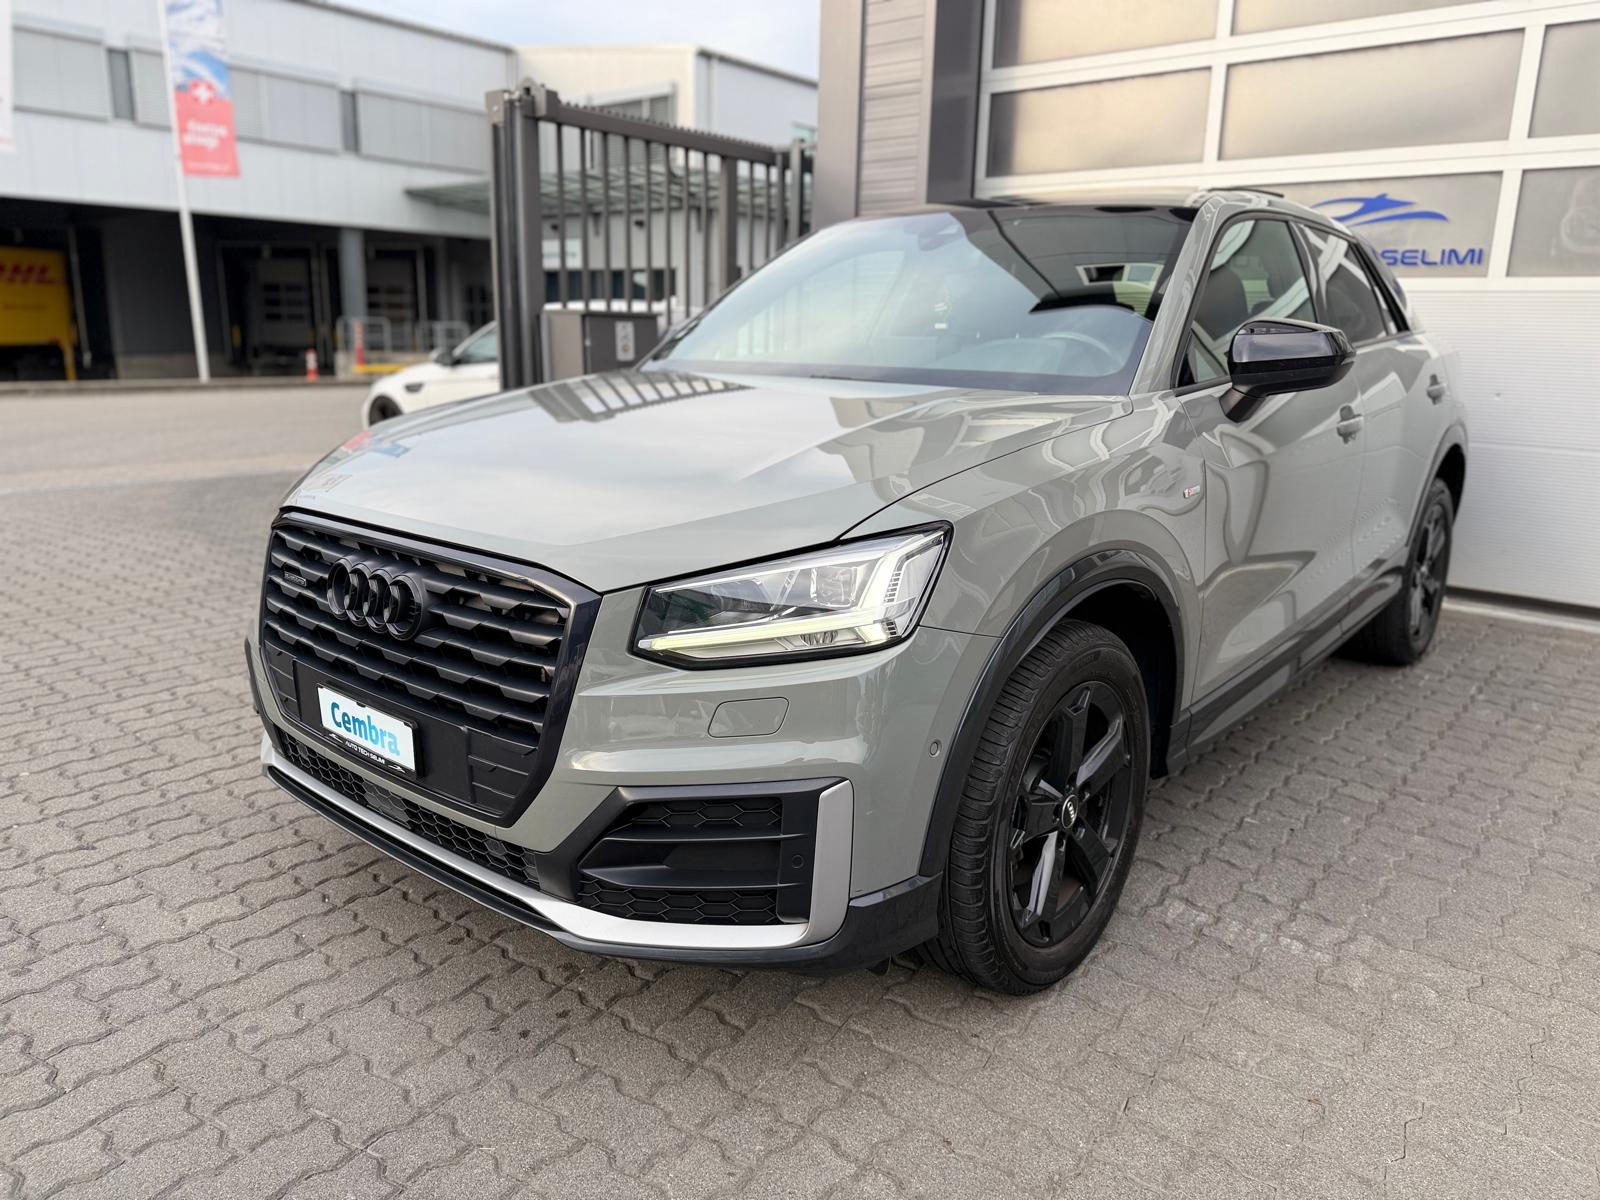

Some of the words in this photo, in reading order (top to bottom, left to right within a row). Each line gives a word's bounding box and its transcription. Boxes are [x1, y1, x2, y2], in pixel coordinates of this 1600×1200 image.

[1380, 248, 1483, 266] SELIMI
[331, 702, 400, 756] Cembra
[345, 741, 358, 751] AUTO
[357, 747, 370, 757] TECH
